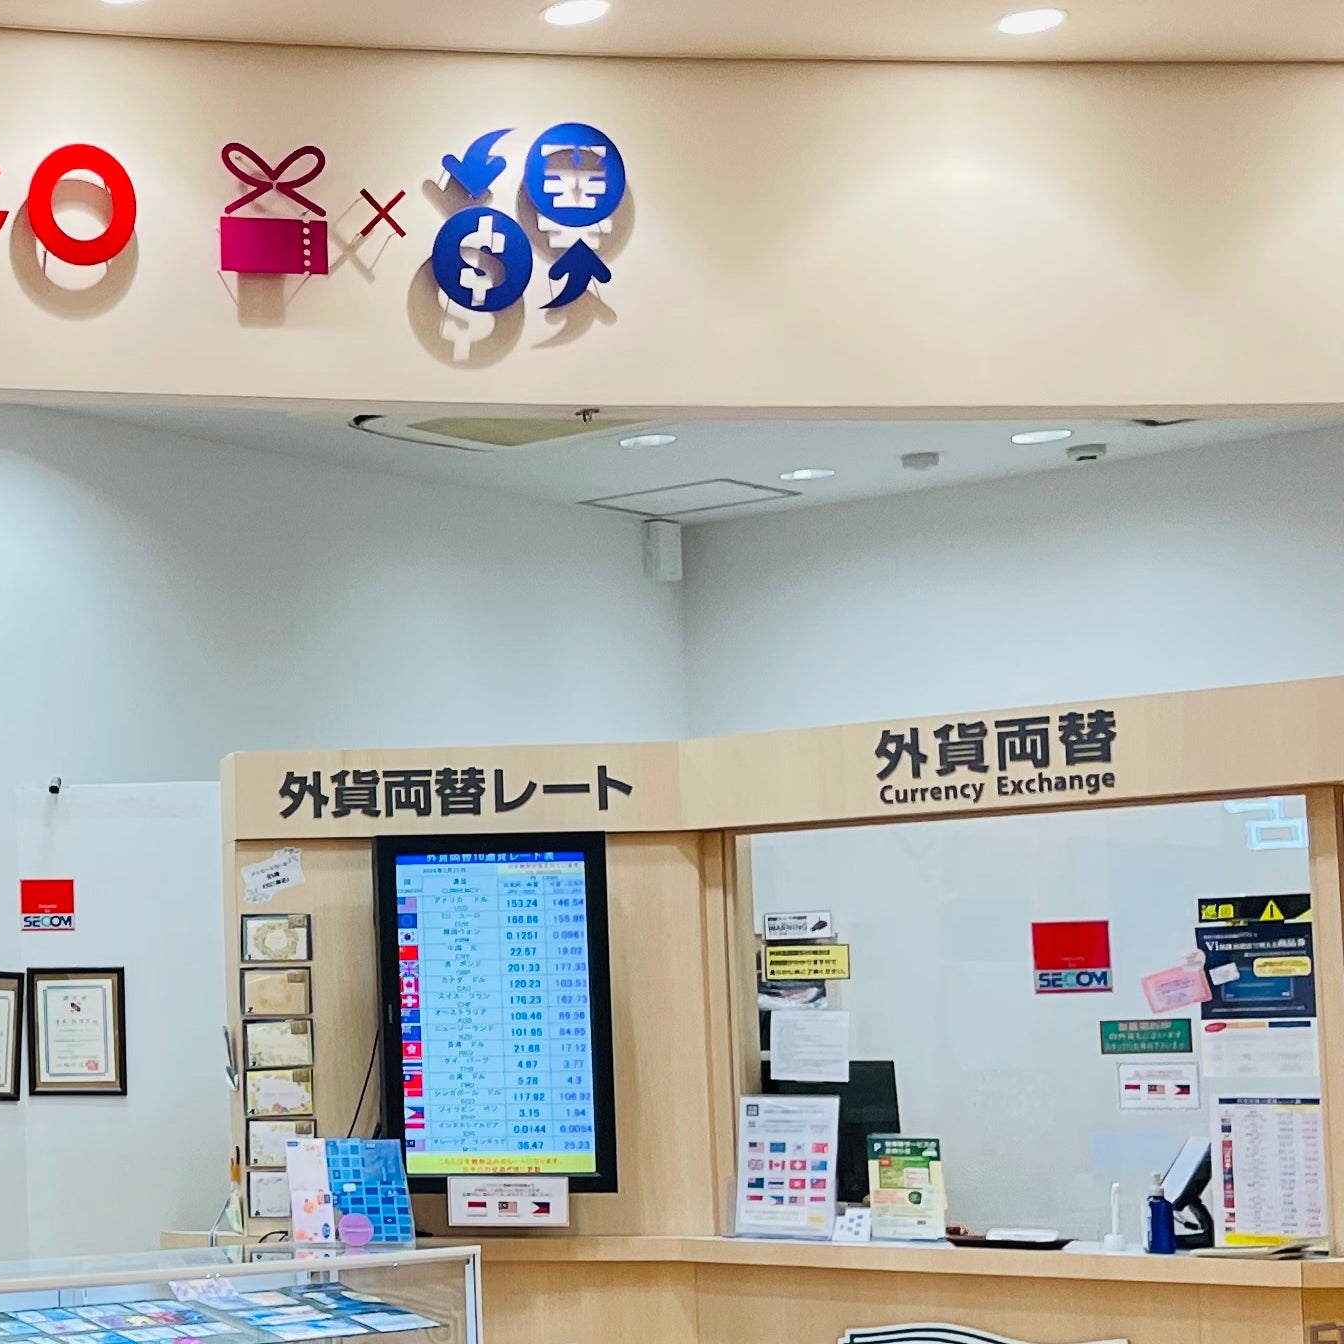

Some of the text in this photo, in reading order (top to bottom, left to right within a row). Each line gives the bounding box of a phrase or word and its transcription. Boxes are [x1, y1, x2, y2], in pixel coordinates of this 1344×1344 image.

[874, 709, 1117, 781] 外貨両替
[278, 764, 633, 820] 外貨両替レート
[879, 771, 1116, 805] Currency Exchange
[23, 915, 72, 928] SECOM
[1038, 971, 1109, 988] SECOM
